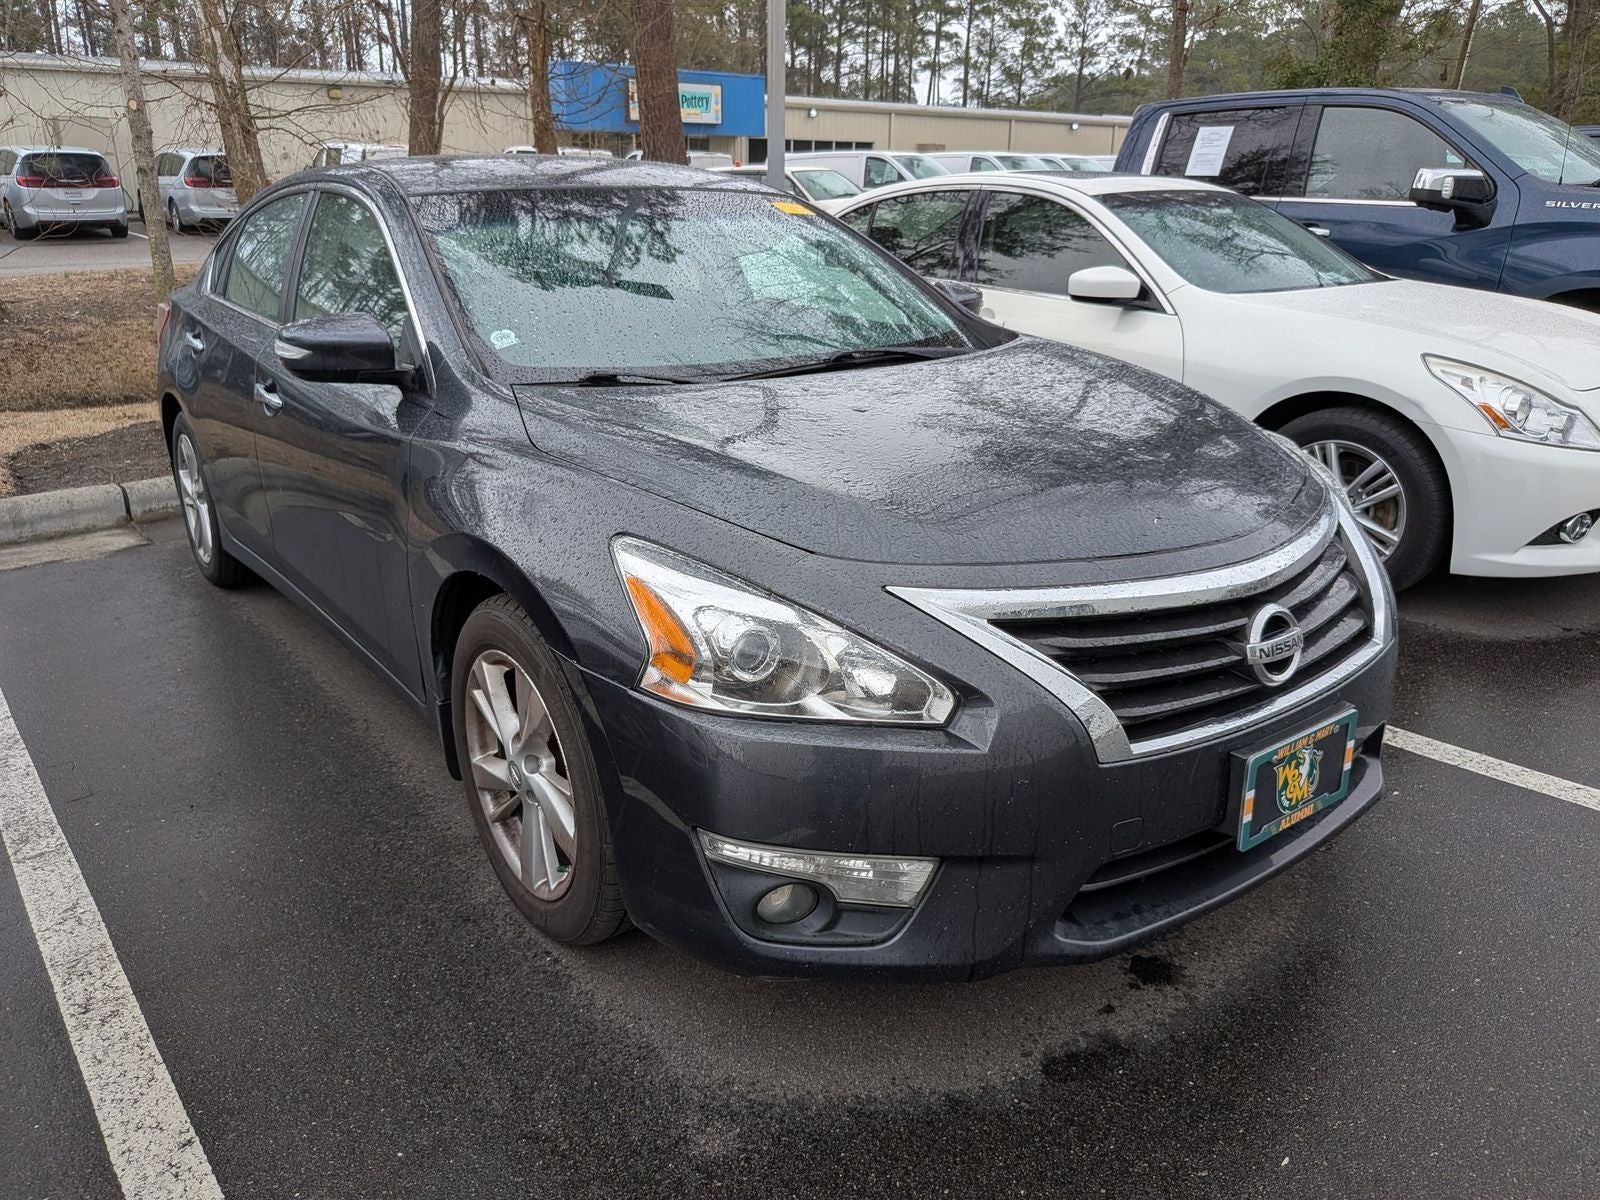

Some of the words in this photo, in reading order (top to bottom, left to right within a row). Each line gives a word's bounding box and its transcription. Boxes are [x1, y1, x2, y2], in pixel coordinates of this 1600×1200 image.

[681, 95, 710, 111] Pottery
[1545, 200, 1600, 210] SILVER
[1258, 634, 1301, 660] NISSAN
[1277, 736, 1308, 760] WILLIAM
[1315, 723, 1335, 742] MARY
[1280, 804, 1314, 831] ALUMNI
